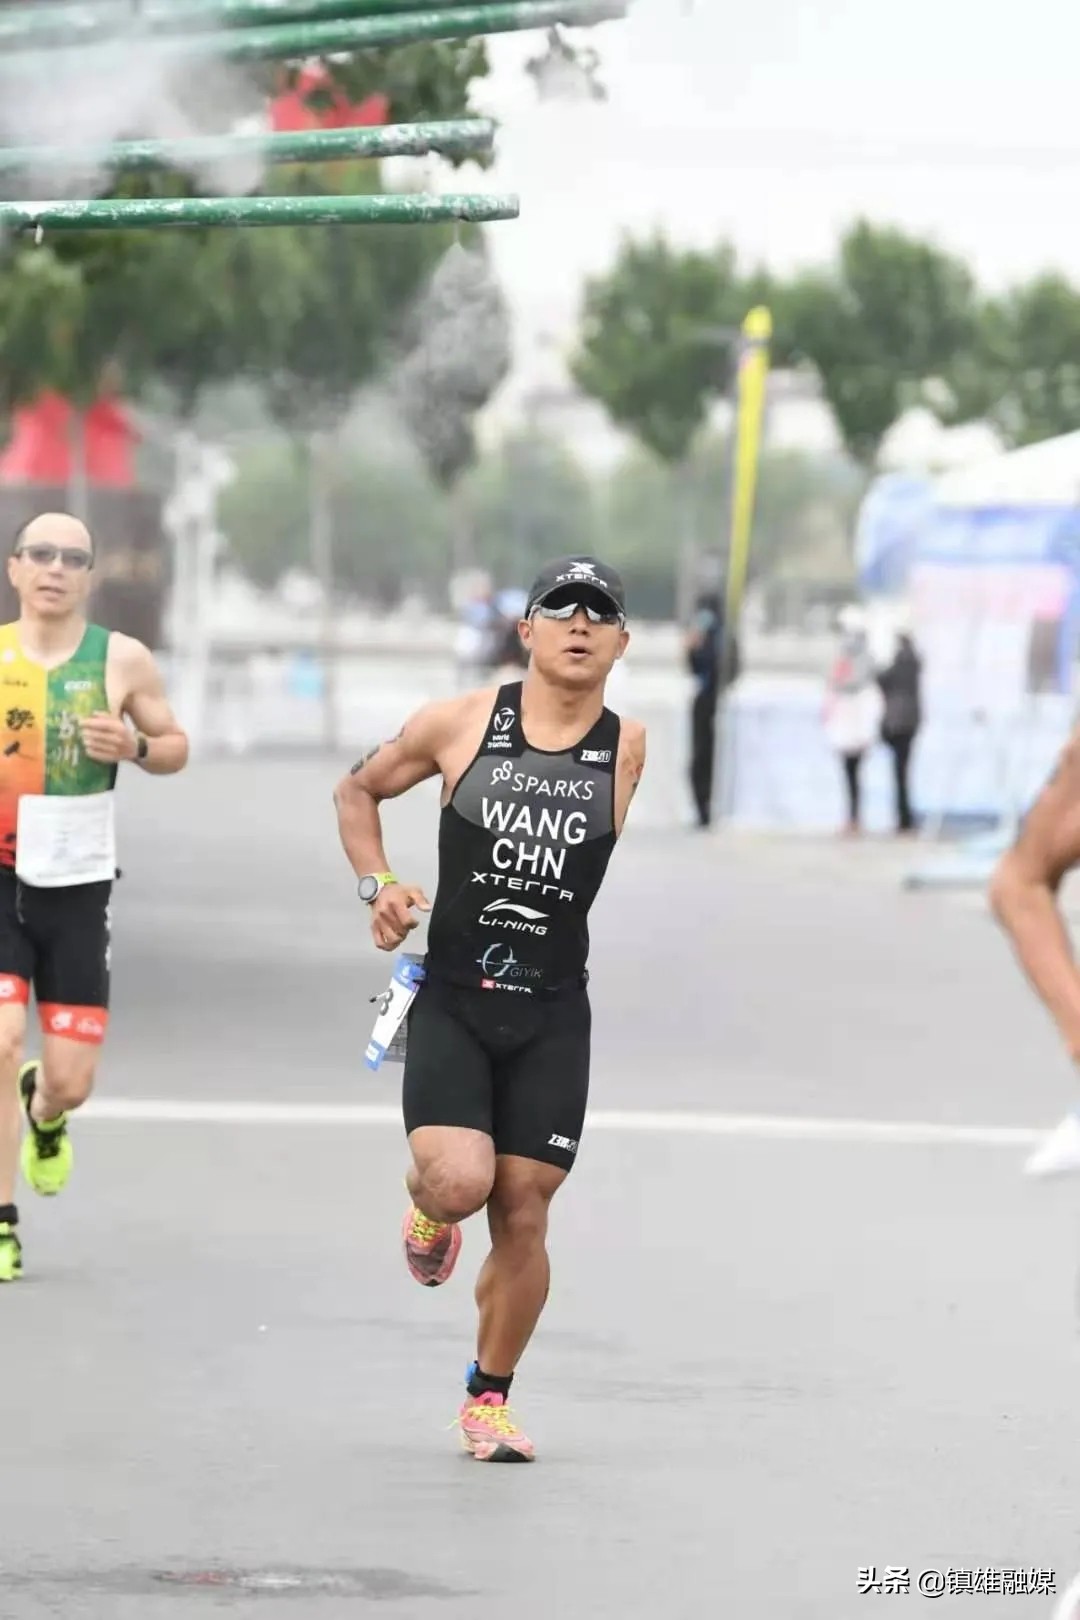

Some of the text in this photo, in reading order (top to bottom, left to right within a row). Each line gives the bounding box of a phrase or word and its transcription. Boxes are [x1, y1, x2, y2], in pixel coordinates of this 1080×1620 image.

[555, 573, 608, 588] XTERRA
[511, 772, 595, 801] SPARKS
[481, 797, 588, 845] WANG
[492, 837, 567, 880] CHN
[470, 871, 575, 902] XTERRA
[478, 914, 548, 936] LI-NING
[495, 982, 533, 994] XTERRA
